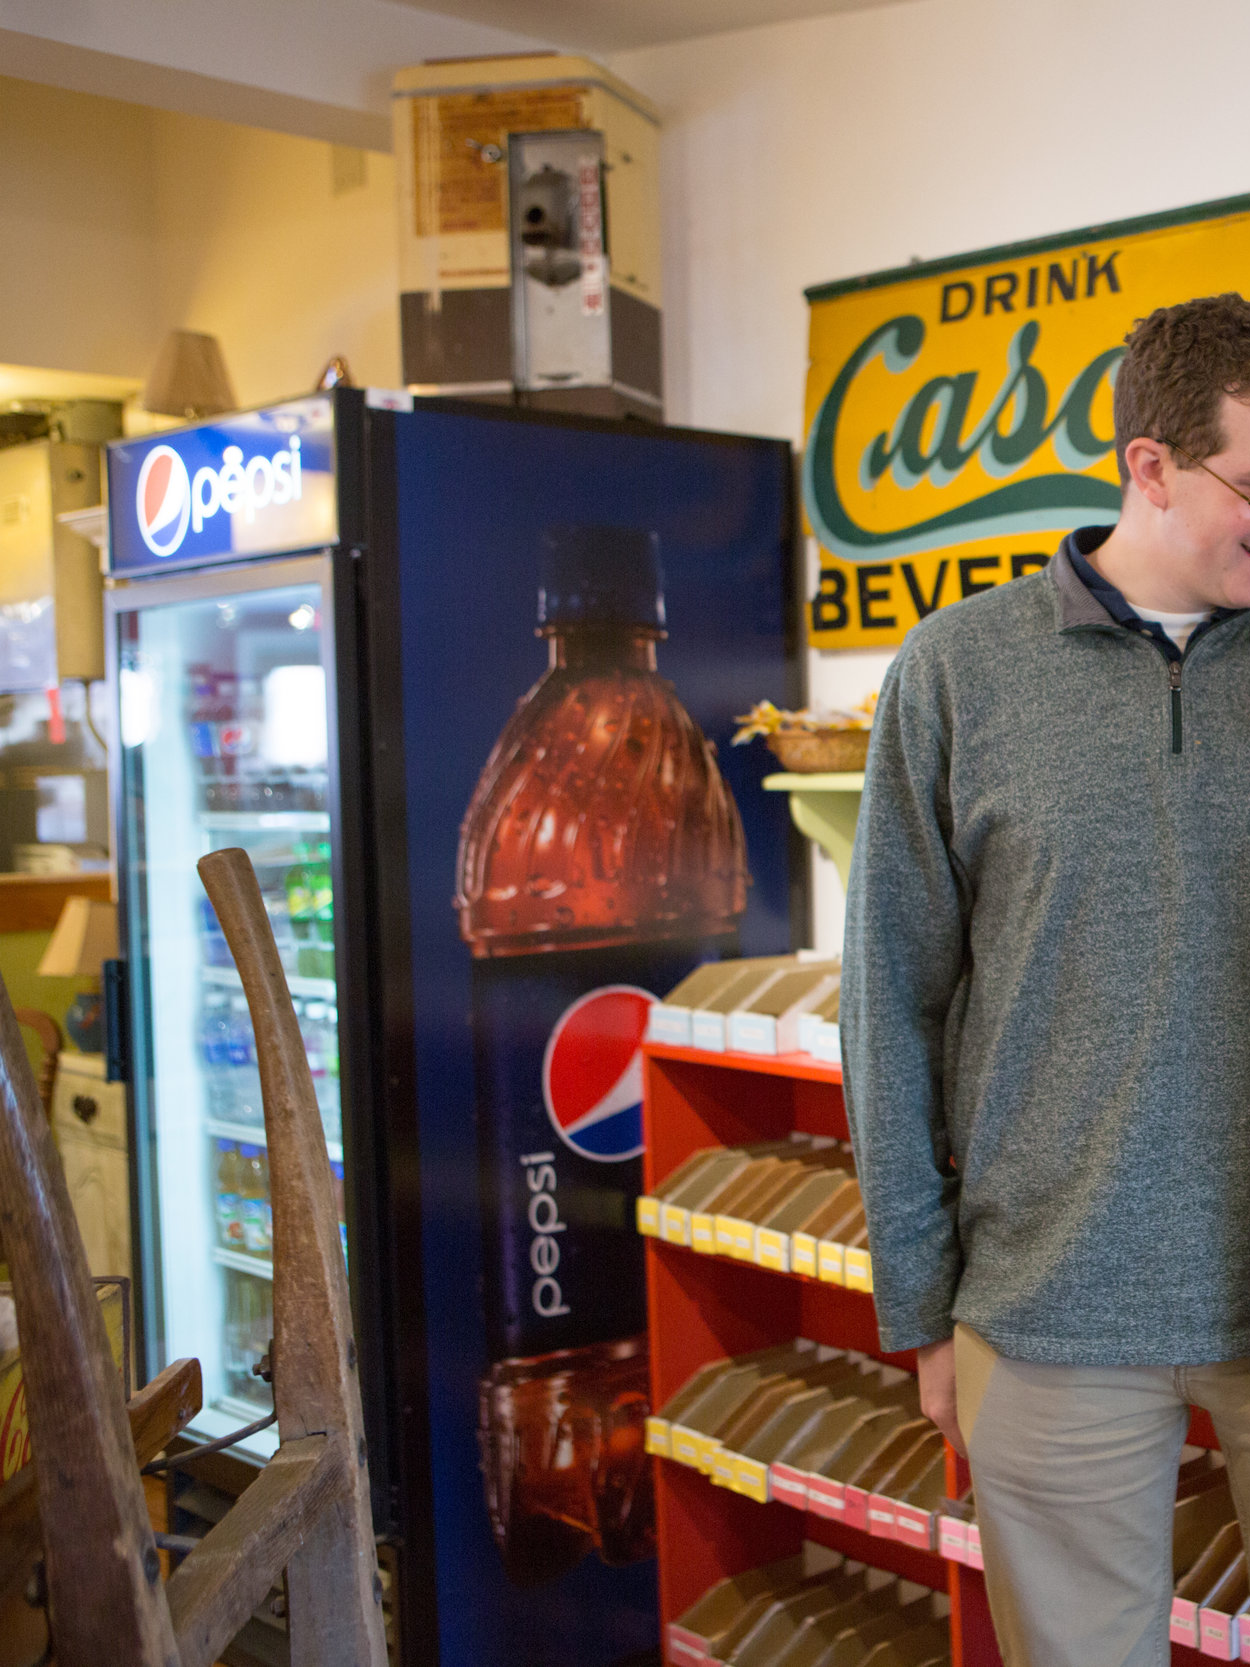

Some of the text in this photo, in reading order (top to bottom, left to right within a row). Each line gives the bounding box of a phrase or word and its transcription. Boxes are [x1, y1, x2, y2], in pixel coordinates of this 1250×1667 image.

[939, 251, 1123, 324] DRINK
[191, 434, 302, 534] pepsi
[519, 1151, 571, 1318] pepsi
